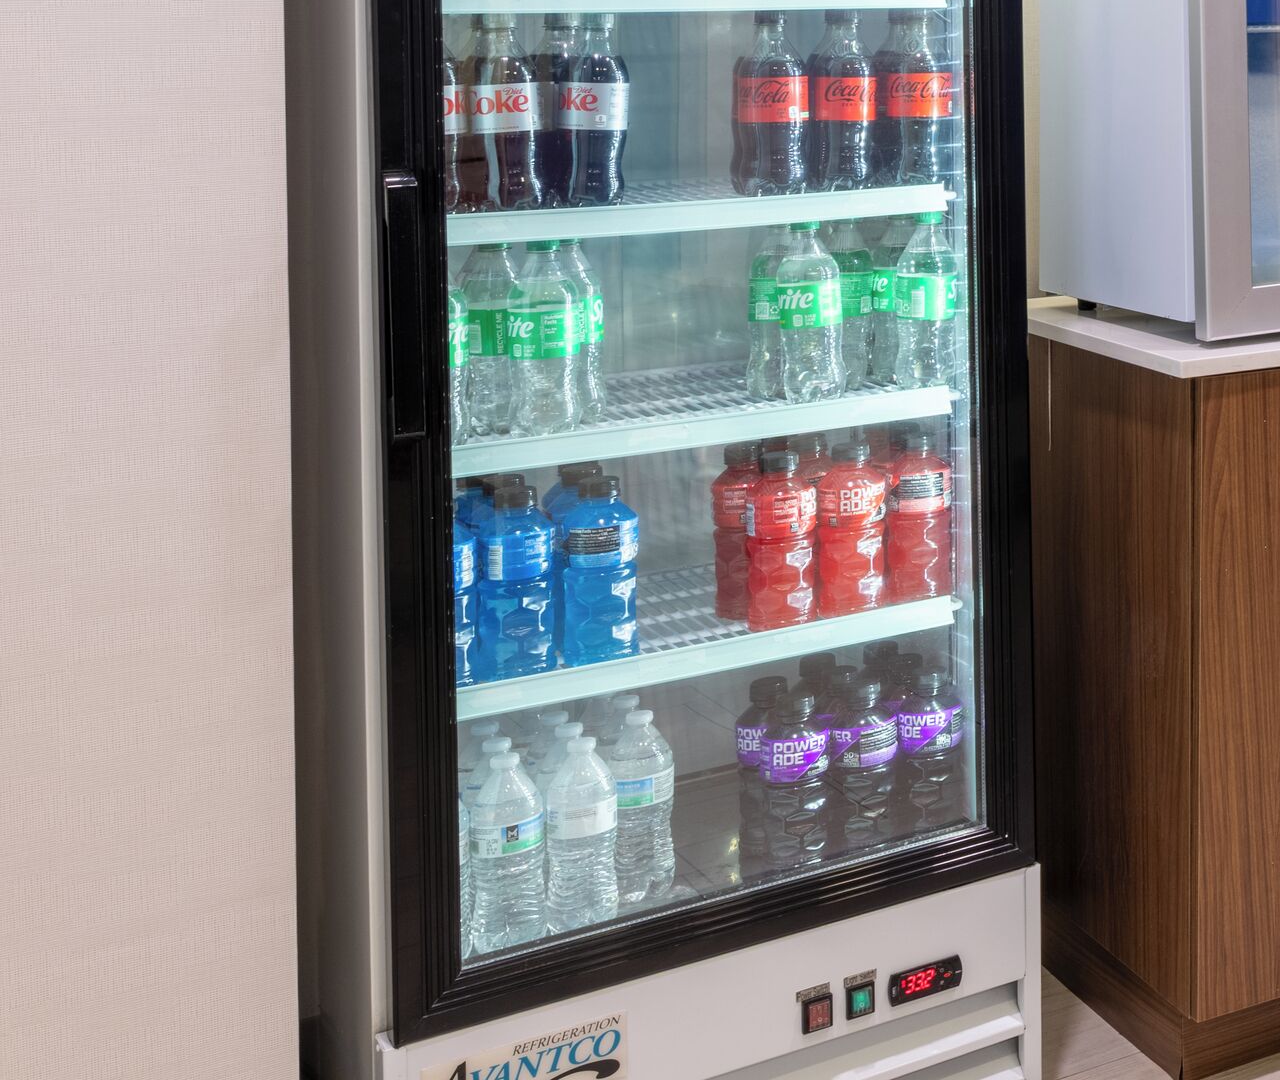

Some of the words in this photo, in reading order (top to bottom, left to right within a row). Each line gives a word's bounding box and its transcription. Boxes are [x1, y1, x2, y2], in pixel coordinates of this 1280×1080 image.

[560, 87, 599, 112] oke
[778, 288, 815, 310] rite
[508, 315, 534, 338] ite
[840, 482, 885, 501] POWER
[840, 500, 871, 512] ADE
[899, 713, 945, 727] POWER
[737, 727, 767, 739] POW
[737, 738, 761, 751] ADE
[773, 735, 826, 753] POWER
[773, 753, 805, 766] ADE
[512, 1014, 622, 1057] REFRIGERATION
[448, 1029, 621, 1080] AVANTCO
